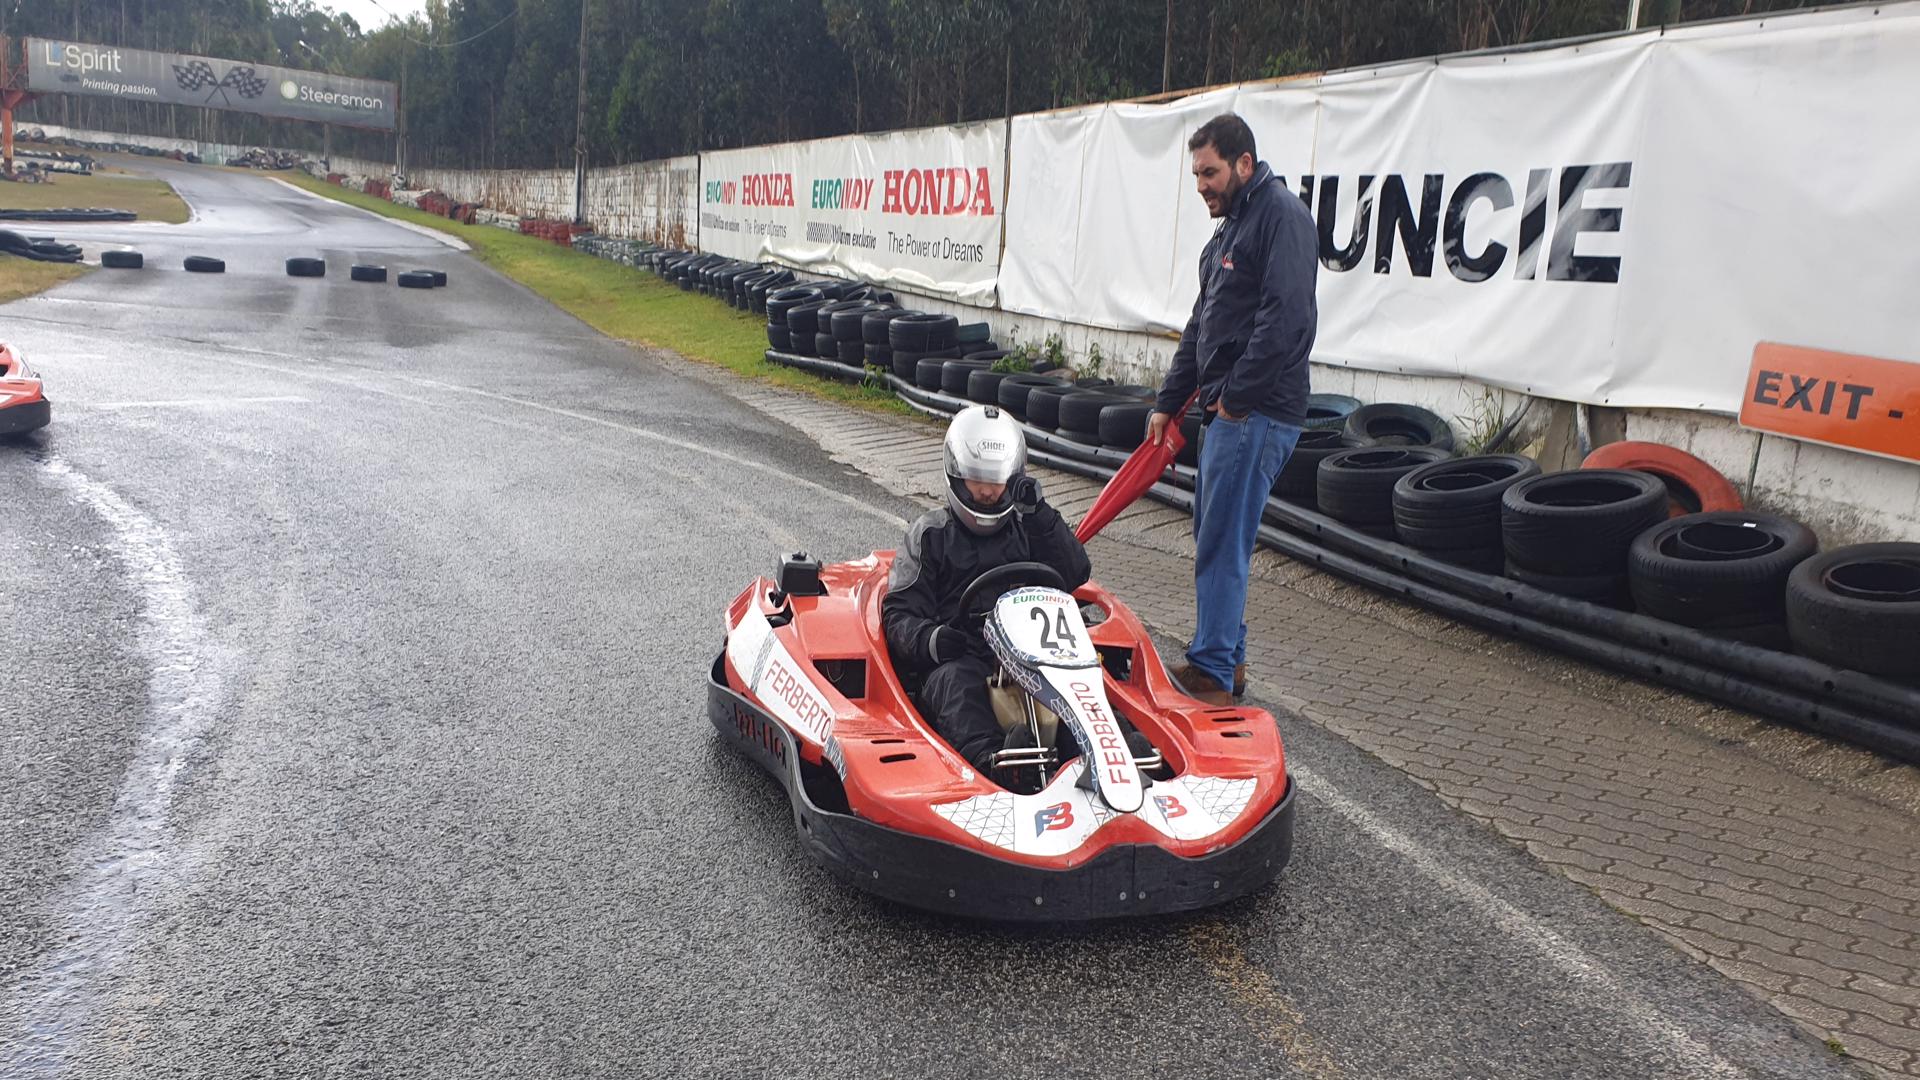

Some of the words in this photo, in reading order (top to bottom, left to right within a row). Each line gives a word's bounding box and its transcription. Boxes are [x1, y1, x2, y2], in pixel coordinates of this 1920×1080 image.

[65, 45, 122, 74] Spirit
[82, 78, 119, 94] Printing
[300, 85, 383, 110] Steersman
[742, 173, 795, 208] HONDA
[812, 178, 874, 211] EUROINDY
[882, 166, 995, 216] HONDA
[888, 231, 904, 254] The
[905, 233, 931, 258] Power
[943, 236, 983, 263] Dreams
[1753, 369, 1875, 421] EXIT
[1013, 594, 1070, 605] EUROINDY
[1030, 606, 1077, 649] 24
[764, 659, 832, 743] FERBERTO
[1070, 682, 1131, 784] FERBERTO
